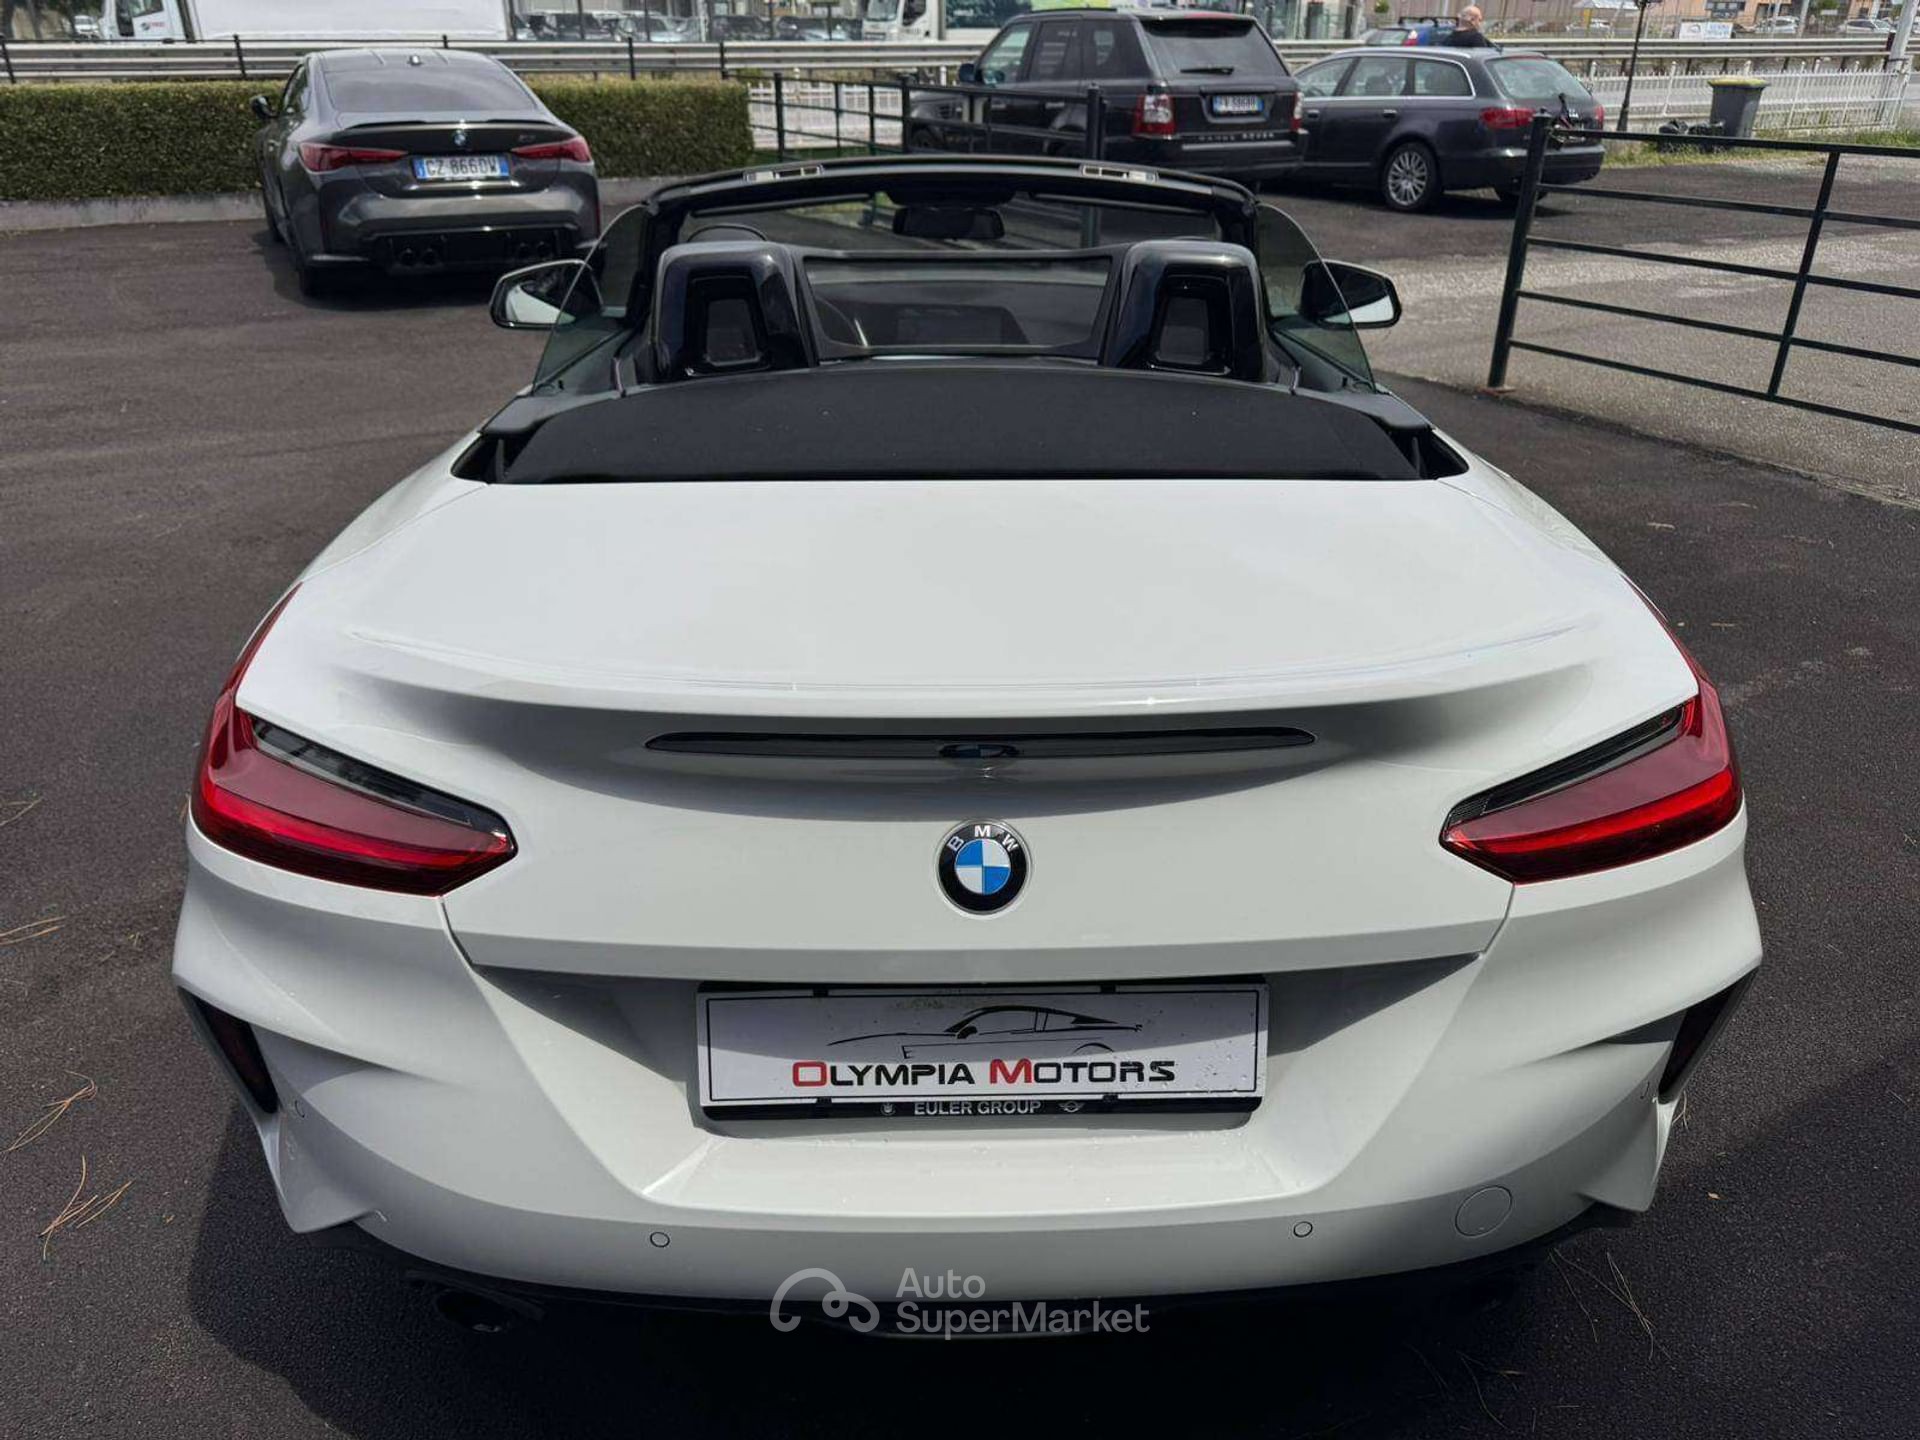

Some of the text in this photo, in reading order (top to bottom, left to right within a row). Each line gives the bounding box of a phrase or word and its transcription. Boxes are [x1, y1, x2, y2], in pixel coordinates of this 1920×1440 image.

[946, 825, 1019, 852] BMW
[792, 1058, 1176, 1087] OLYMPIA MOTORS
[914, 1100, 1042, 1116] EULER GROUP
